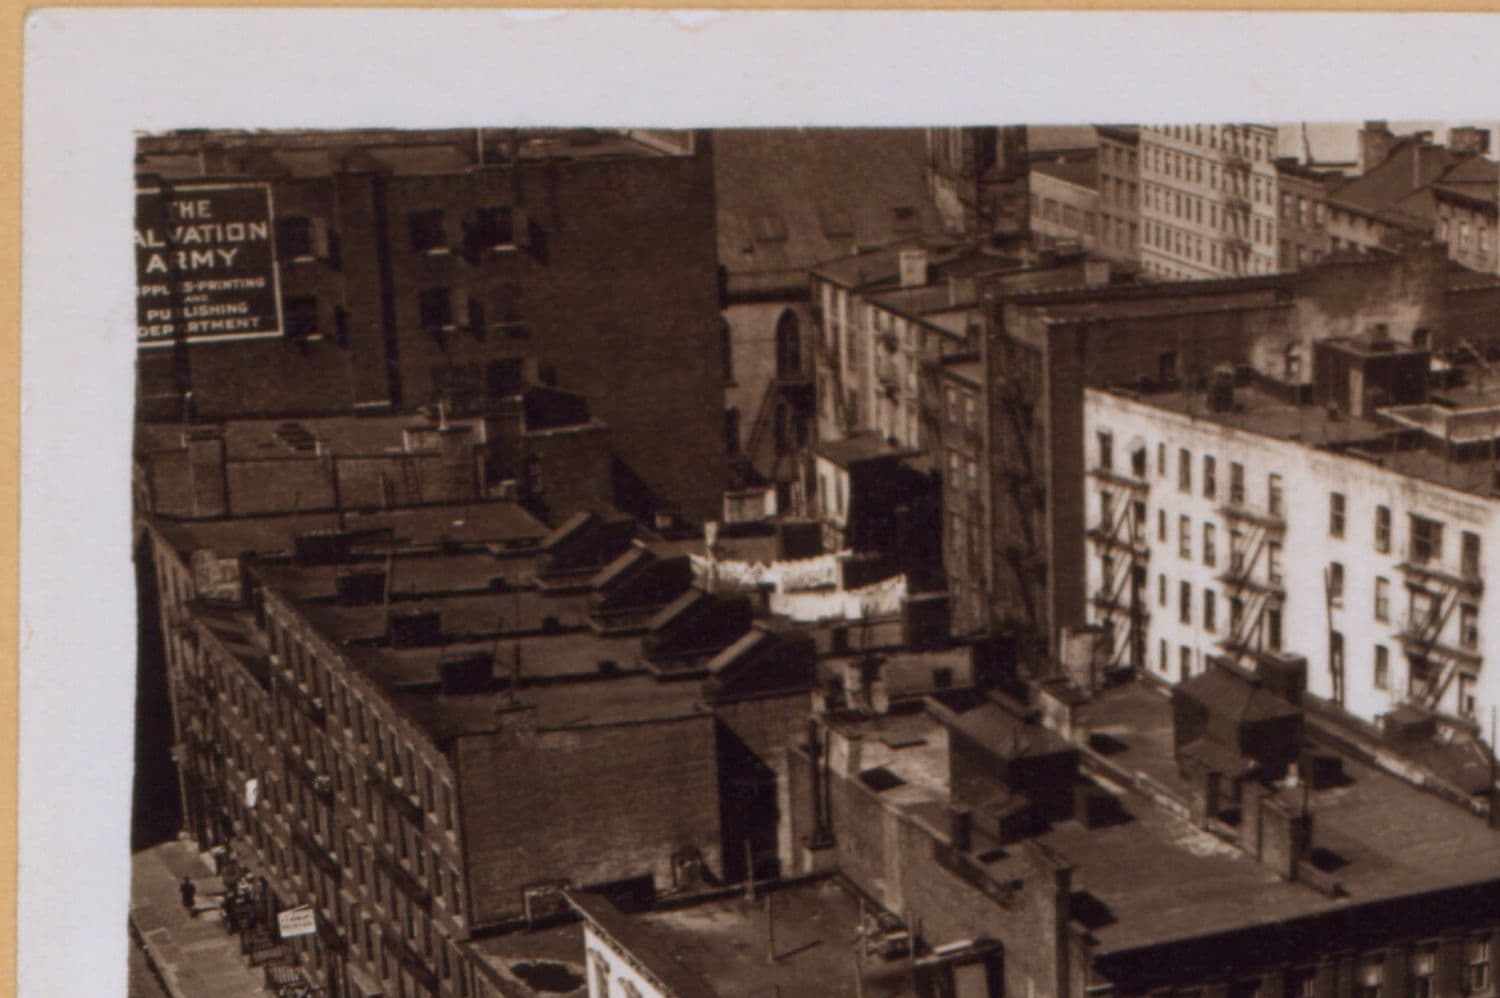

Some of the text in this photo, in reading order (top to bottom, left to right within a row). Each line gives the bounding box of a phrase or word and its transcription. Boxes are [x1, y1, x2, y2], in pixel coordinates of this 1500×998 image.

[173, 200, 212, 219] HE
[134, 222, 267, 247] ALATION
[146, 301, 248, 322] PULISHING
[138, 316, 260, 338] DEPRTMENT
